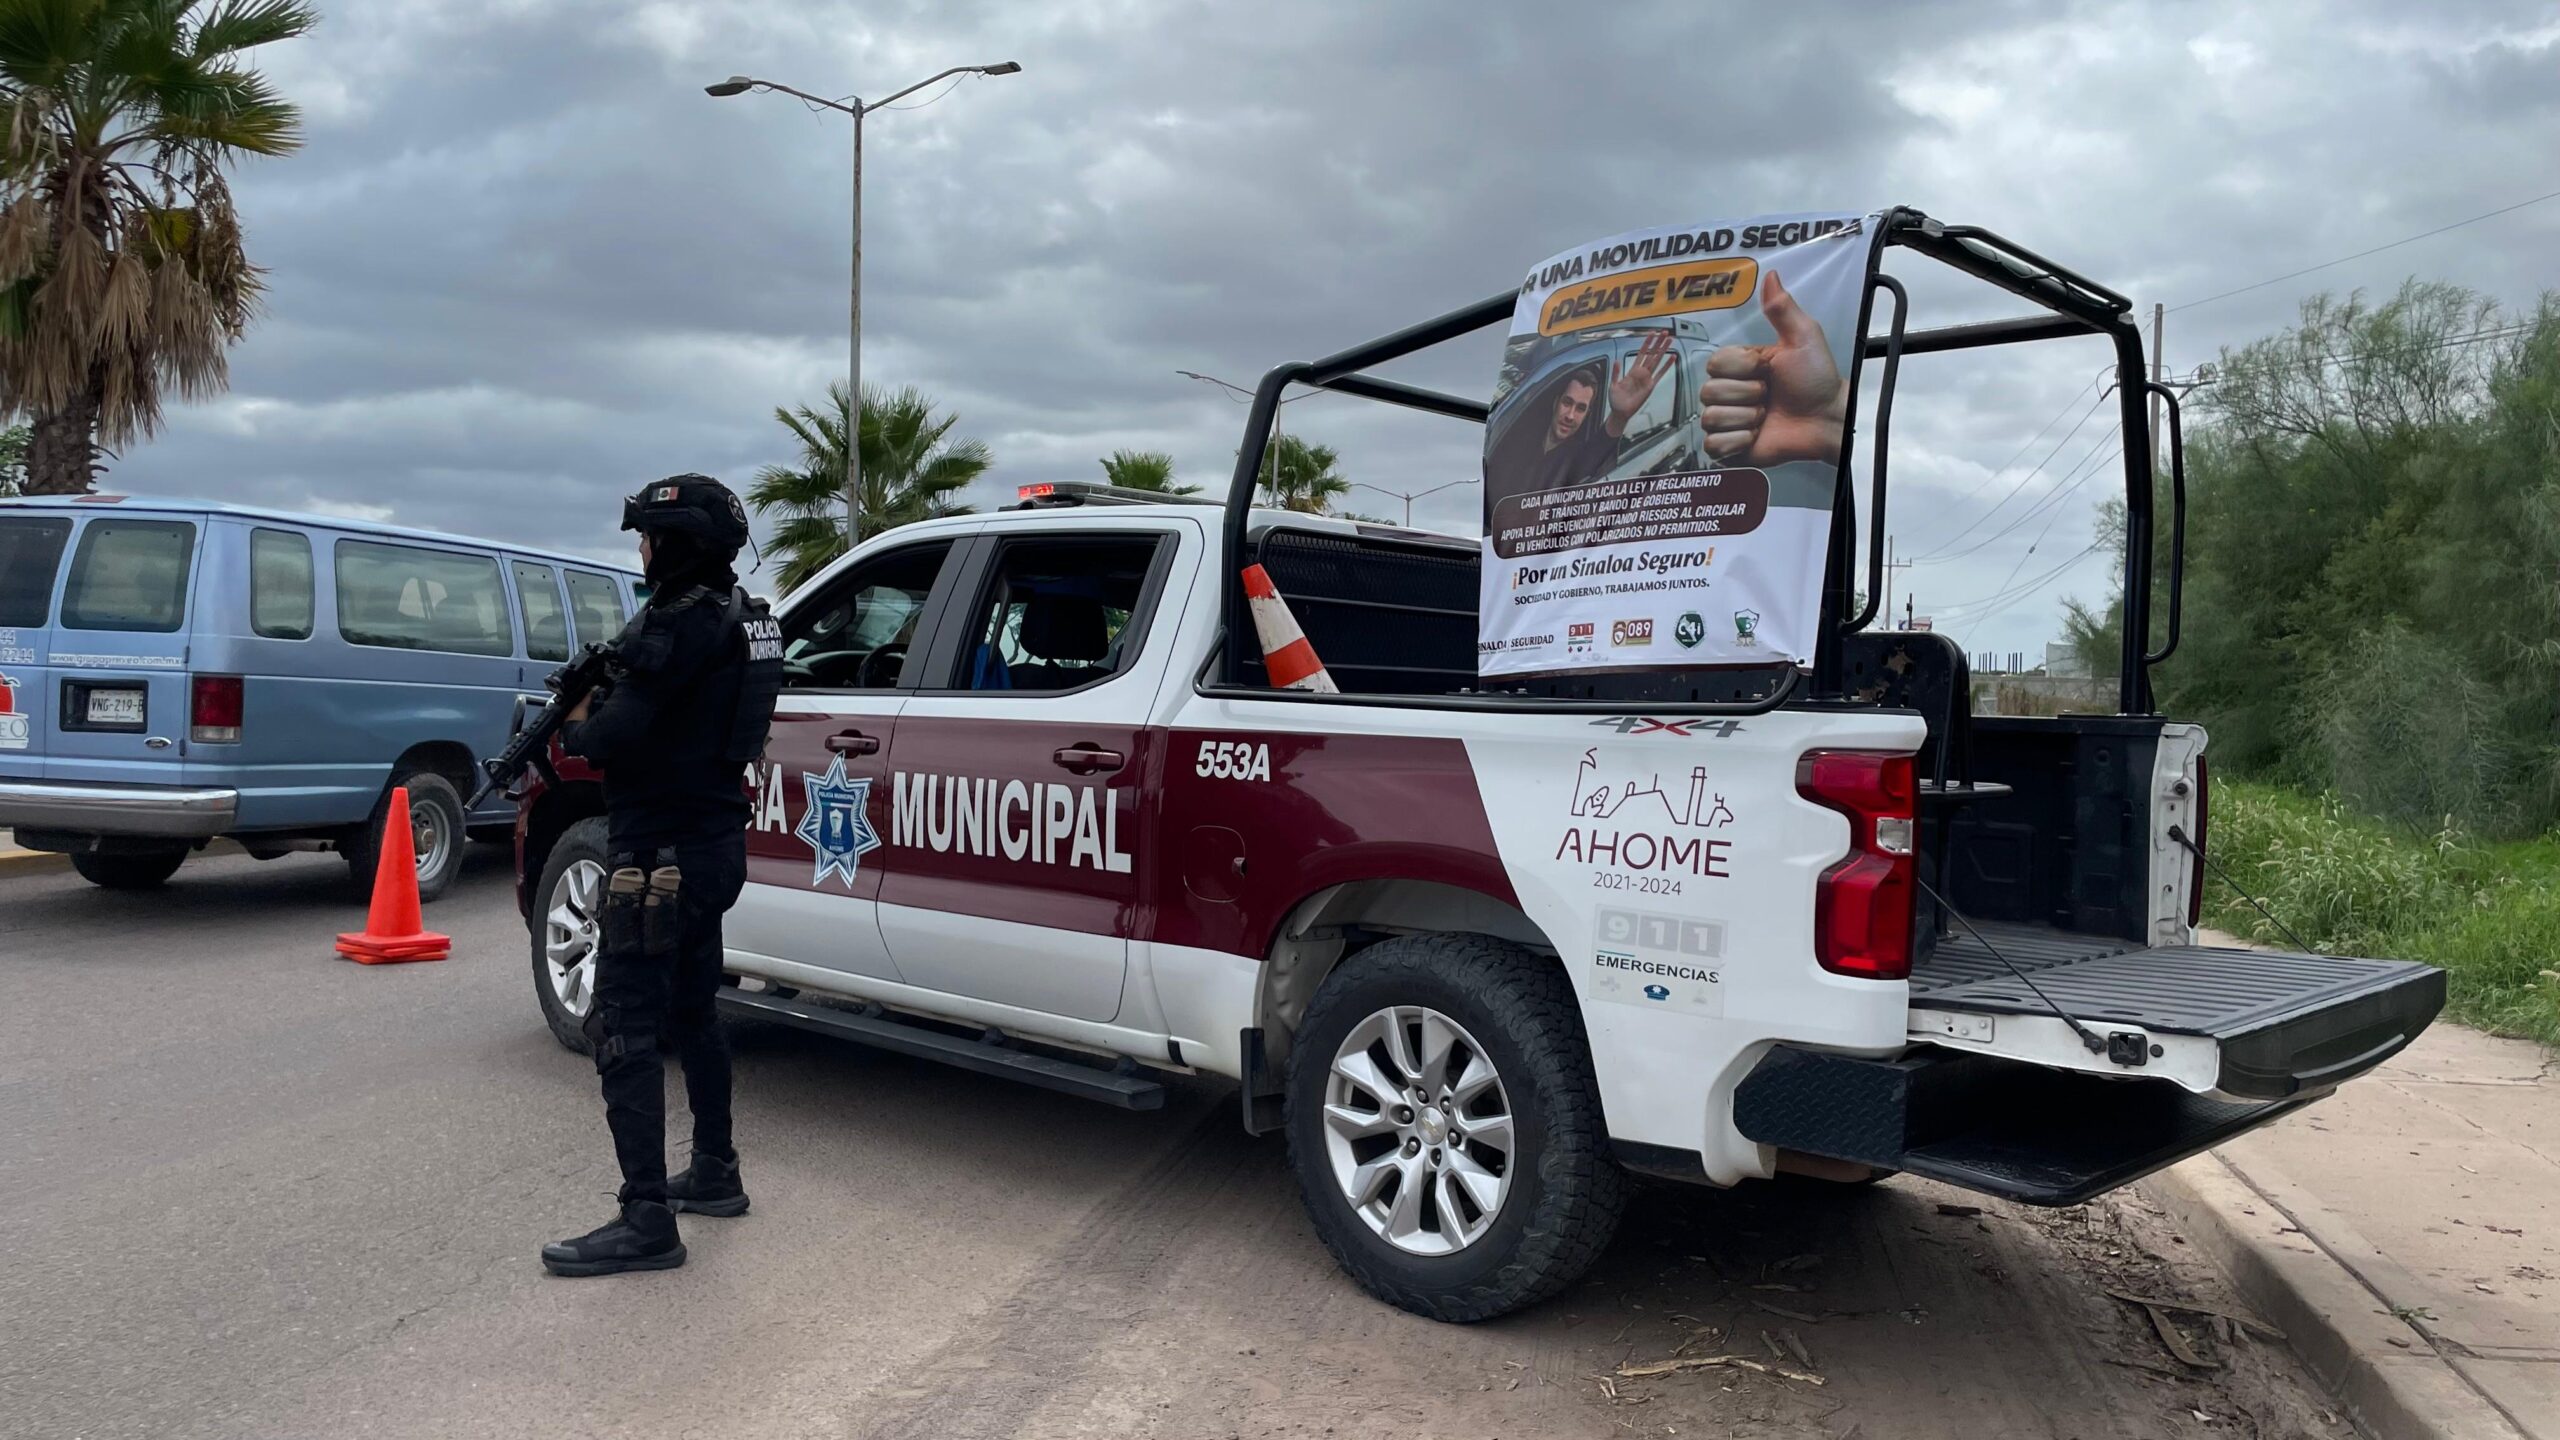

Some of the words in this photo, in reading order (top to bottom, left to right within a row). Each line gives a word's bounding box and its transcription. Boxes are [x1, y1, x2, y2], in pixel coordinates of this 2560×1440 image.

[1540, 256, 1583, 287] UNA
[1589, 229, 1734, 272] MOVILIDAD
[1740, 218, 1863, 248] SEGURA
[1547, 280, 1660, 329] ¡DÉJATE
[1666, 270, 1740, 300] VER!
[1521, 497, 1540, 509] CADA
[1542, 490, 1584, 506] MUNICIPIO
[1585, 486, 1614, 500] APLICA
[1616, 483, 1627, 494] LA
[1629, 481, 1647, 493] LEY
[1650, 480, 1657, 492] Y
[1656, 474, 1721, 490] REGLAMENTO
[1539, 509, 1549, 520] DE
[1552, 503, 1590, 519] TRÁNSITO
[1592, 501, 1598, 513] Y
[1599, 498, 1628, 512] BANDO
[1630, 497, 1642, 509] DE
[1643, 491, 1691, 507] GOBIERNO.
[1501, 527, 1523, 541] APOYA
[1525, 525, 1535, 537] EN
[1536, 524, 1545, 536] LA
[1597, 511, 1639, 527] EVITANDO
[1639, 507, 1679, 522] RIESGOS
[1680, 506, 1692, 519] AL
[1695, 503, 1746, 517] CIRCULAR
[1516, 541, 1525, 553] EN
[1527, 535, 1569, 552] VEHÍCULOS
[1570, 533, 1585, 546] CON
[1585, 526, 1642, 543] POLARIZADOS
[1644, 524, 1658, 537] NO
[1659, 520, 1720, 535] PERMITIDOS.
[1512, 567, 1548, 590] ¡Por
[1550, 565, 1567, 582] un
[1570, 554, 1633, 578] Sinaloa
[1637, 546, 1715, 574] Seguro!
[1514, 592, 1551, 606] SOCIEDAD
[1552, 590, 1558, 600] Y
[1559, 585, 1603, 600] GOBIERNO,
[1605, 581, 1667, 595] TRABAJAMOS
[1668, 577, 1710, 591] JUNTOS.
[1511, 634, 1554, 648] SEGURIDAD
[1570, 625, 1592, 636] 911
[1627, 621, 1651, 637] 089
[0, 648, 33, 662] 2244
[749, 640, 784, 661] MUNICIPAL
[1196, 740, 1271, 782] 553A
[892, 771, 1132, 874] MUNICIPAL
[1556, 828, 1732, 878] AHOME
[1593, 872, 1682, 896] 2021-2024
[1607, 915, 1708, 951] 911
[1595, 954, 1719, 984] EMERGENCIAS
